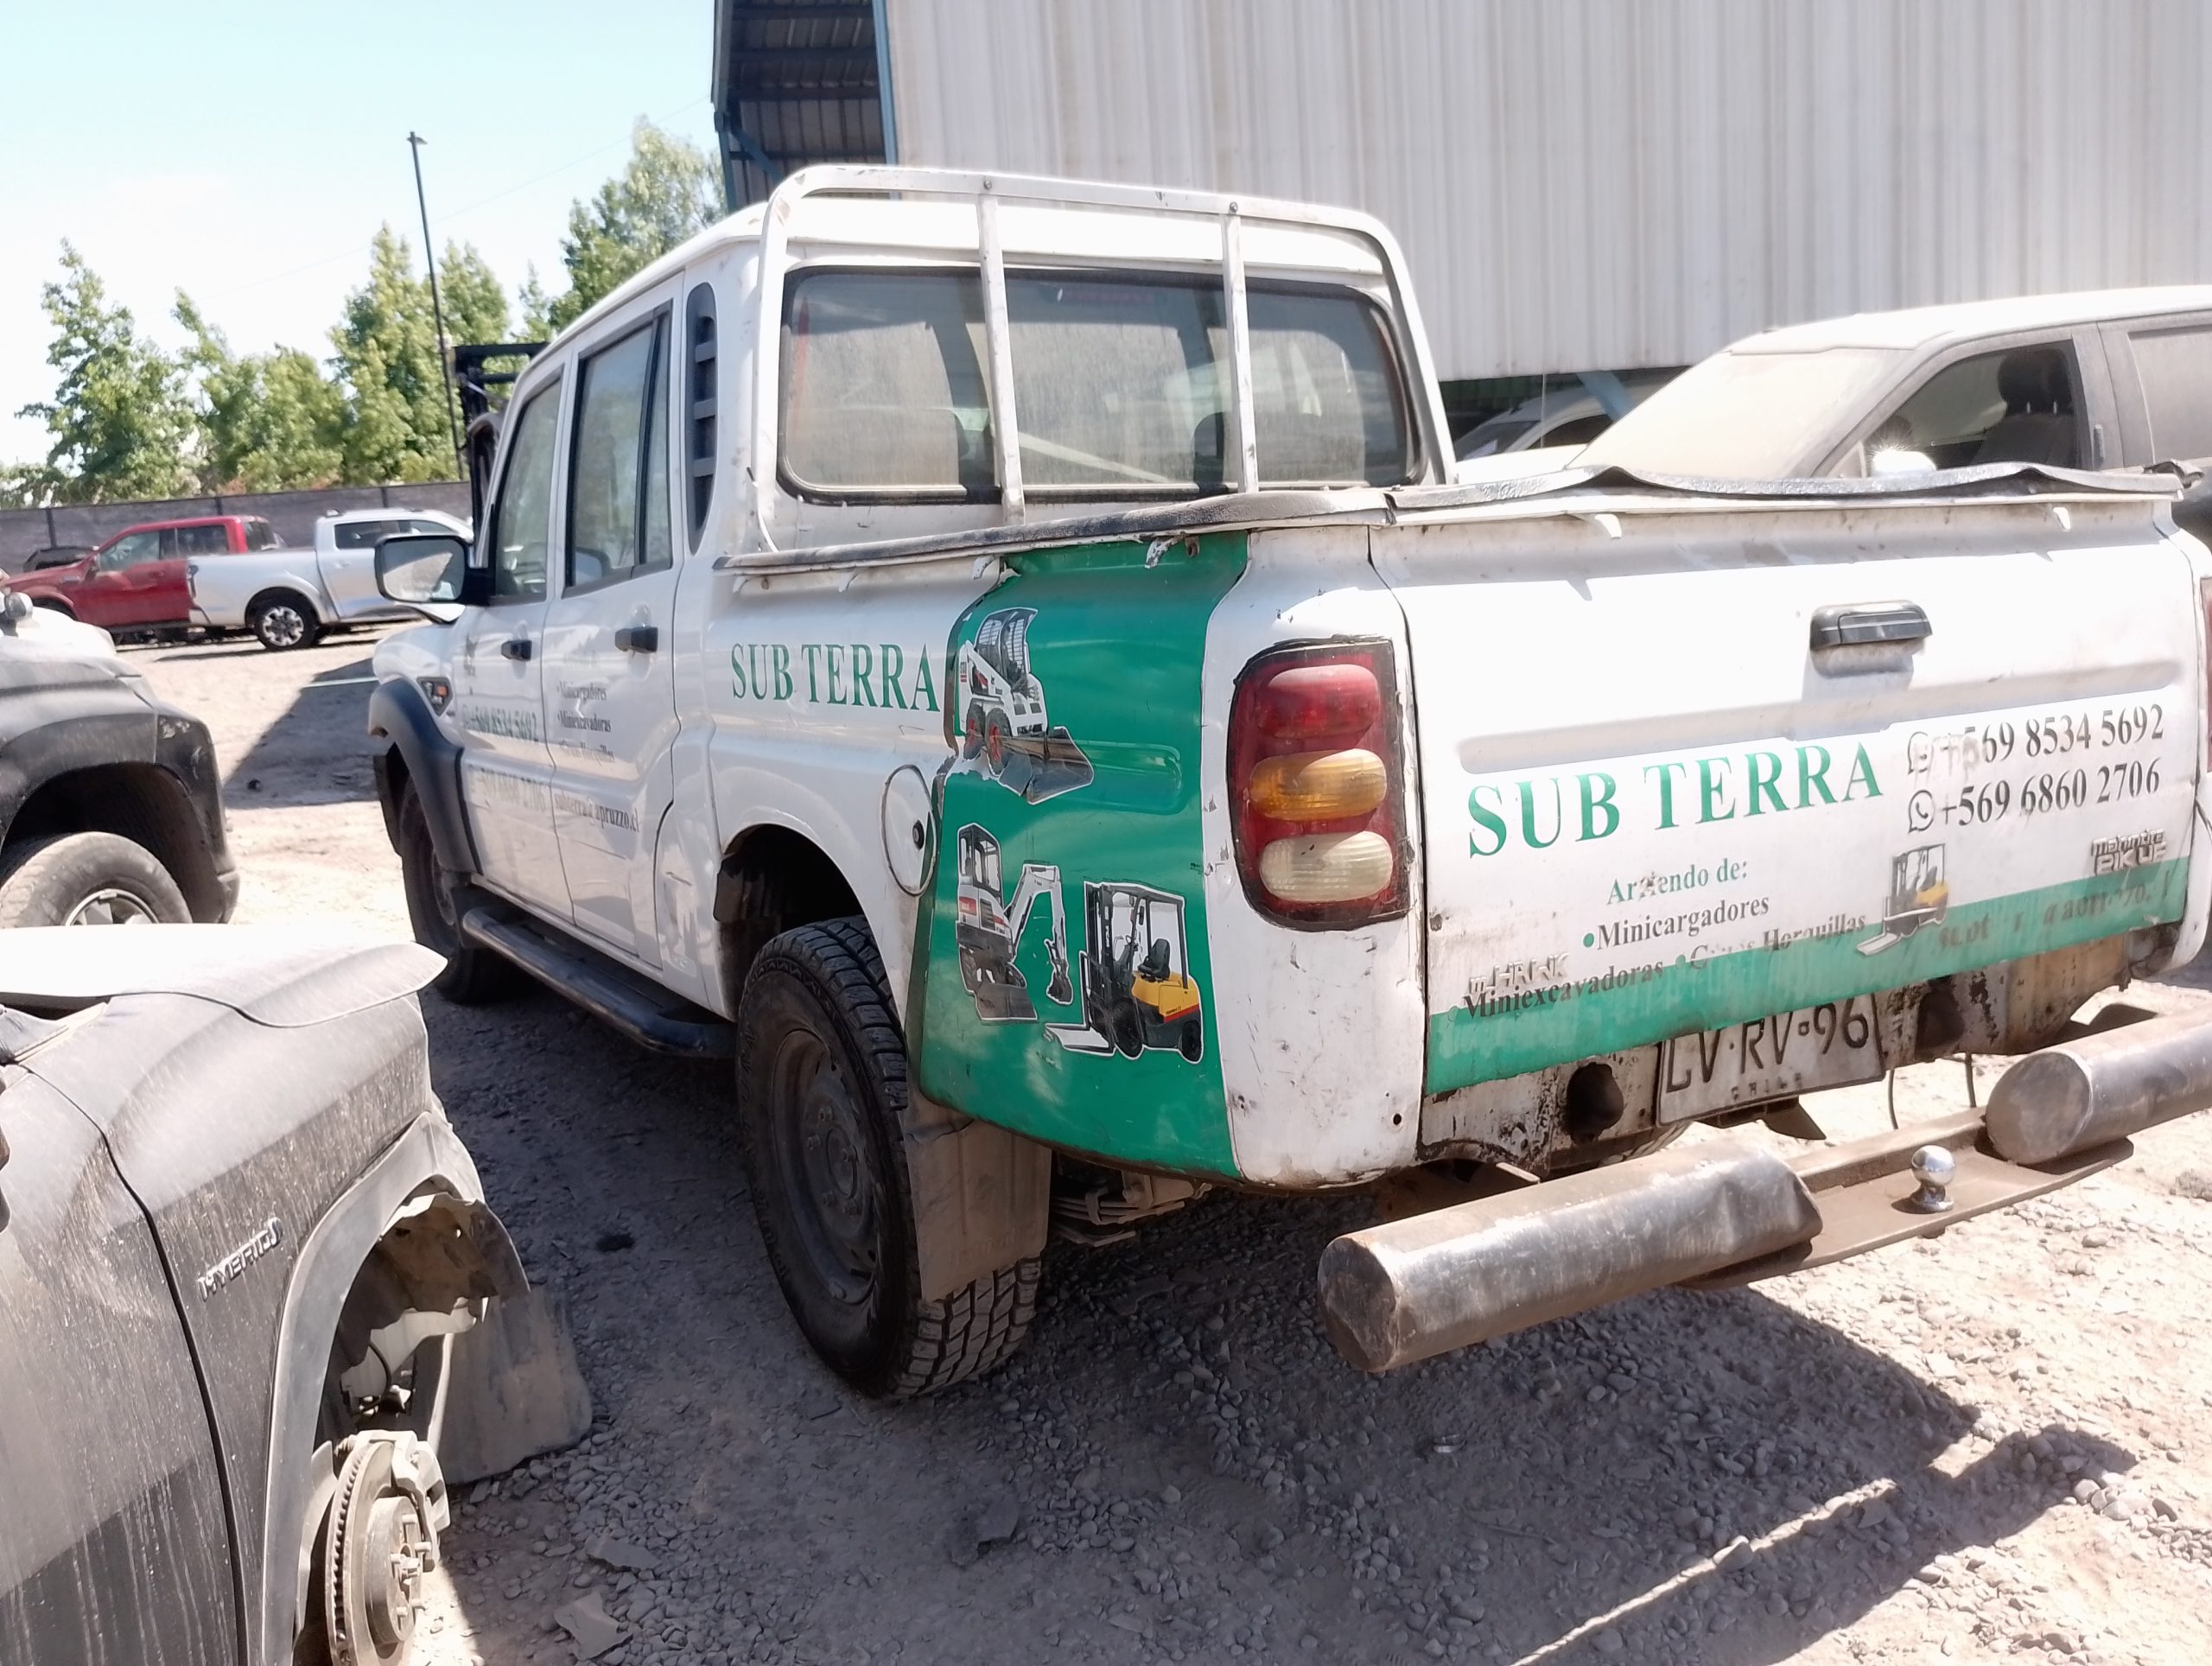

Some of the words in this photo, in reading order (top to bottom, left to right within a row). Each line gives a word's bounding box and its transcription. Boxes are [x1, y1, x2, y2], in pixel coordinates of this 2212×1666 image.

[731, 642, 793, 701] SUB
[801, 643, 940, 712] TERRA
[2024, 712, 2092, 758] 8534
[2101, 703, 2164, 748] 5692
[1467, 771, 1620, 859] SUB
[1642, 741, 1884, 831] TERRA
[1941, 779, 2012, 826] +569
[2019, 768, 2088, 817] 6860
[2096, 757, 2161, 804] 2706
[1597, 896, 1770, 951] Minicargadores
[1462, 959, 1664, 1020] Miniexcavadoras
